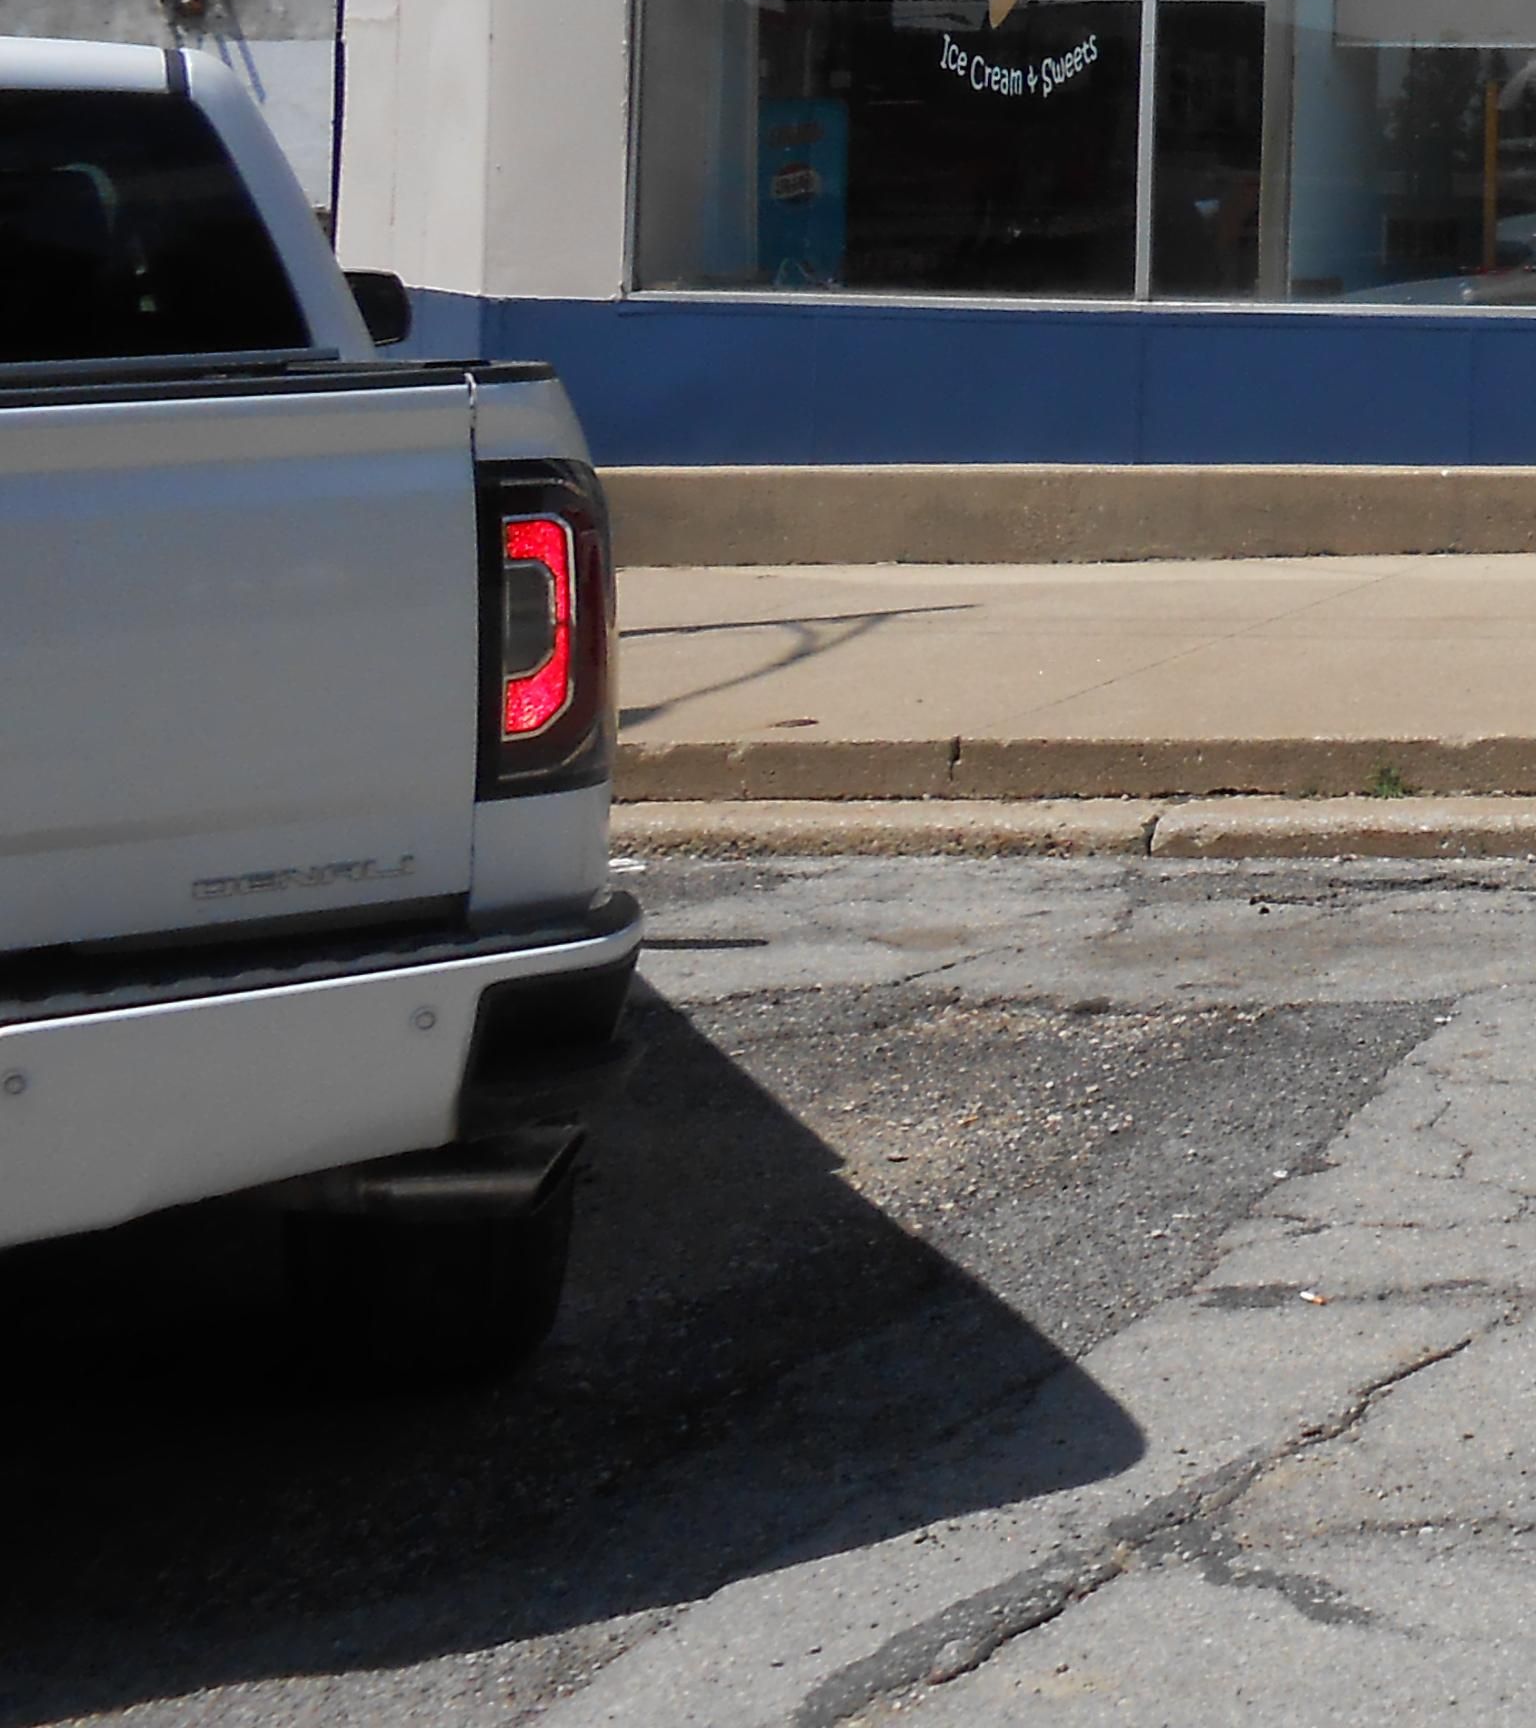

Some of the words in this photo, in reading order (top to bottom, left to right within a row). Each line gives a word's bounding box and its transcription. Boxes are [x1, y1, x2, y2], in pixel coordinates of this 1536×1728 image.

[940, 34, 967, 76] Ice
[970, 55, 1023, 96] Cream
[1027, 65, 1038, 94] &
[1041, 34, 1098, 98] Sweets
[192, 855, 414, 900] DENALI
